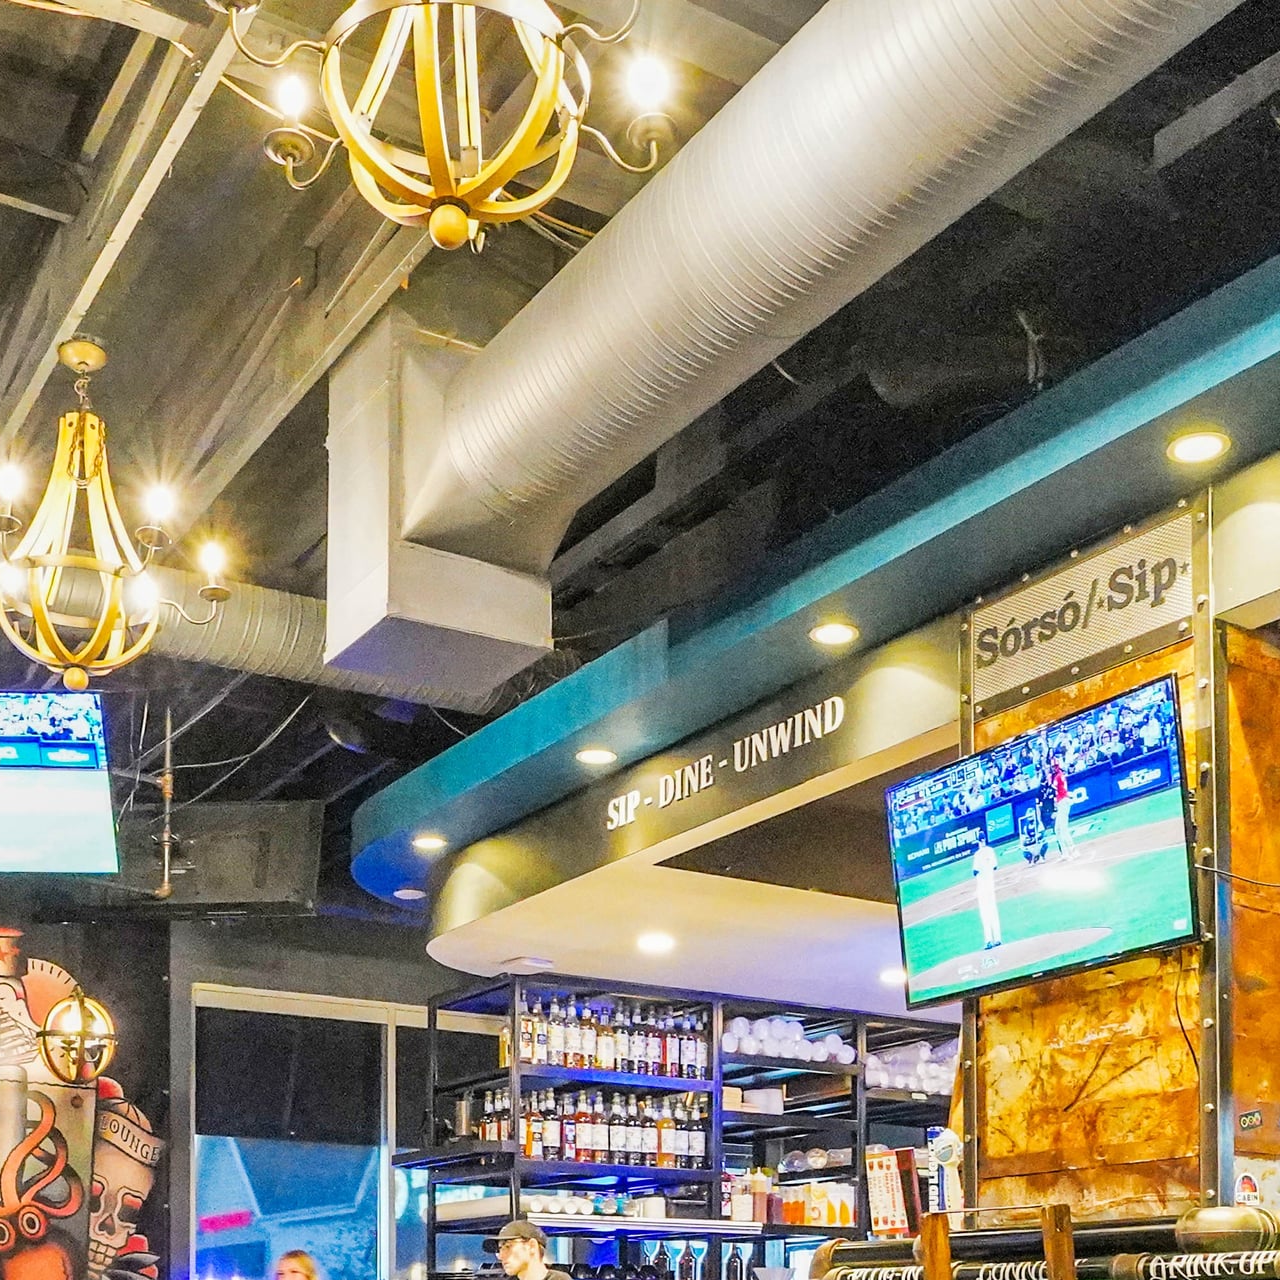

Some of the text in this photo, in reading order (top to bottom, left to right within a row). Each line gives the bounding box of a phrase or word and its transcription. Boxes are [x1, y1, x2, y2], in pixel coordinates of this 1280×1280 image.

[607, 789, 641, 830] SIP
[658, 754, 714, 808] DINE
[733, 696, 845, 772] UNWIND
[101, 1115, 160, 1163] LOUNGE
[1237, 1194, 1259, 1202] CABIN
